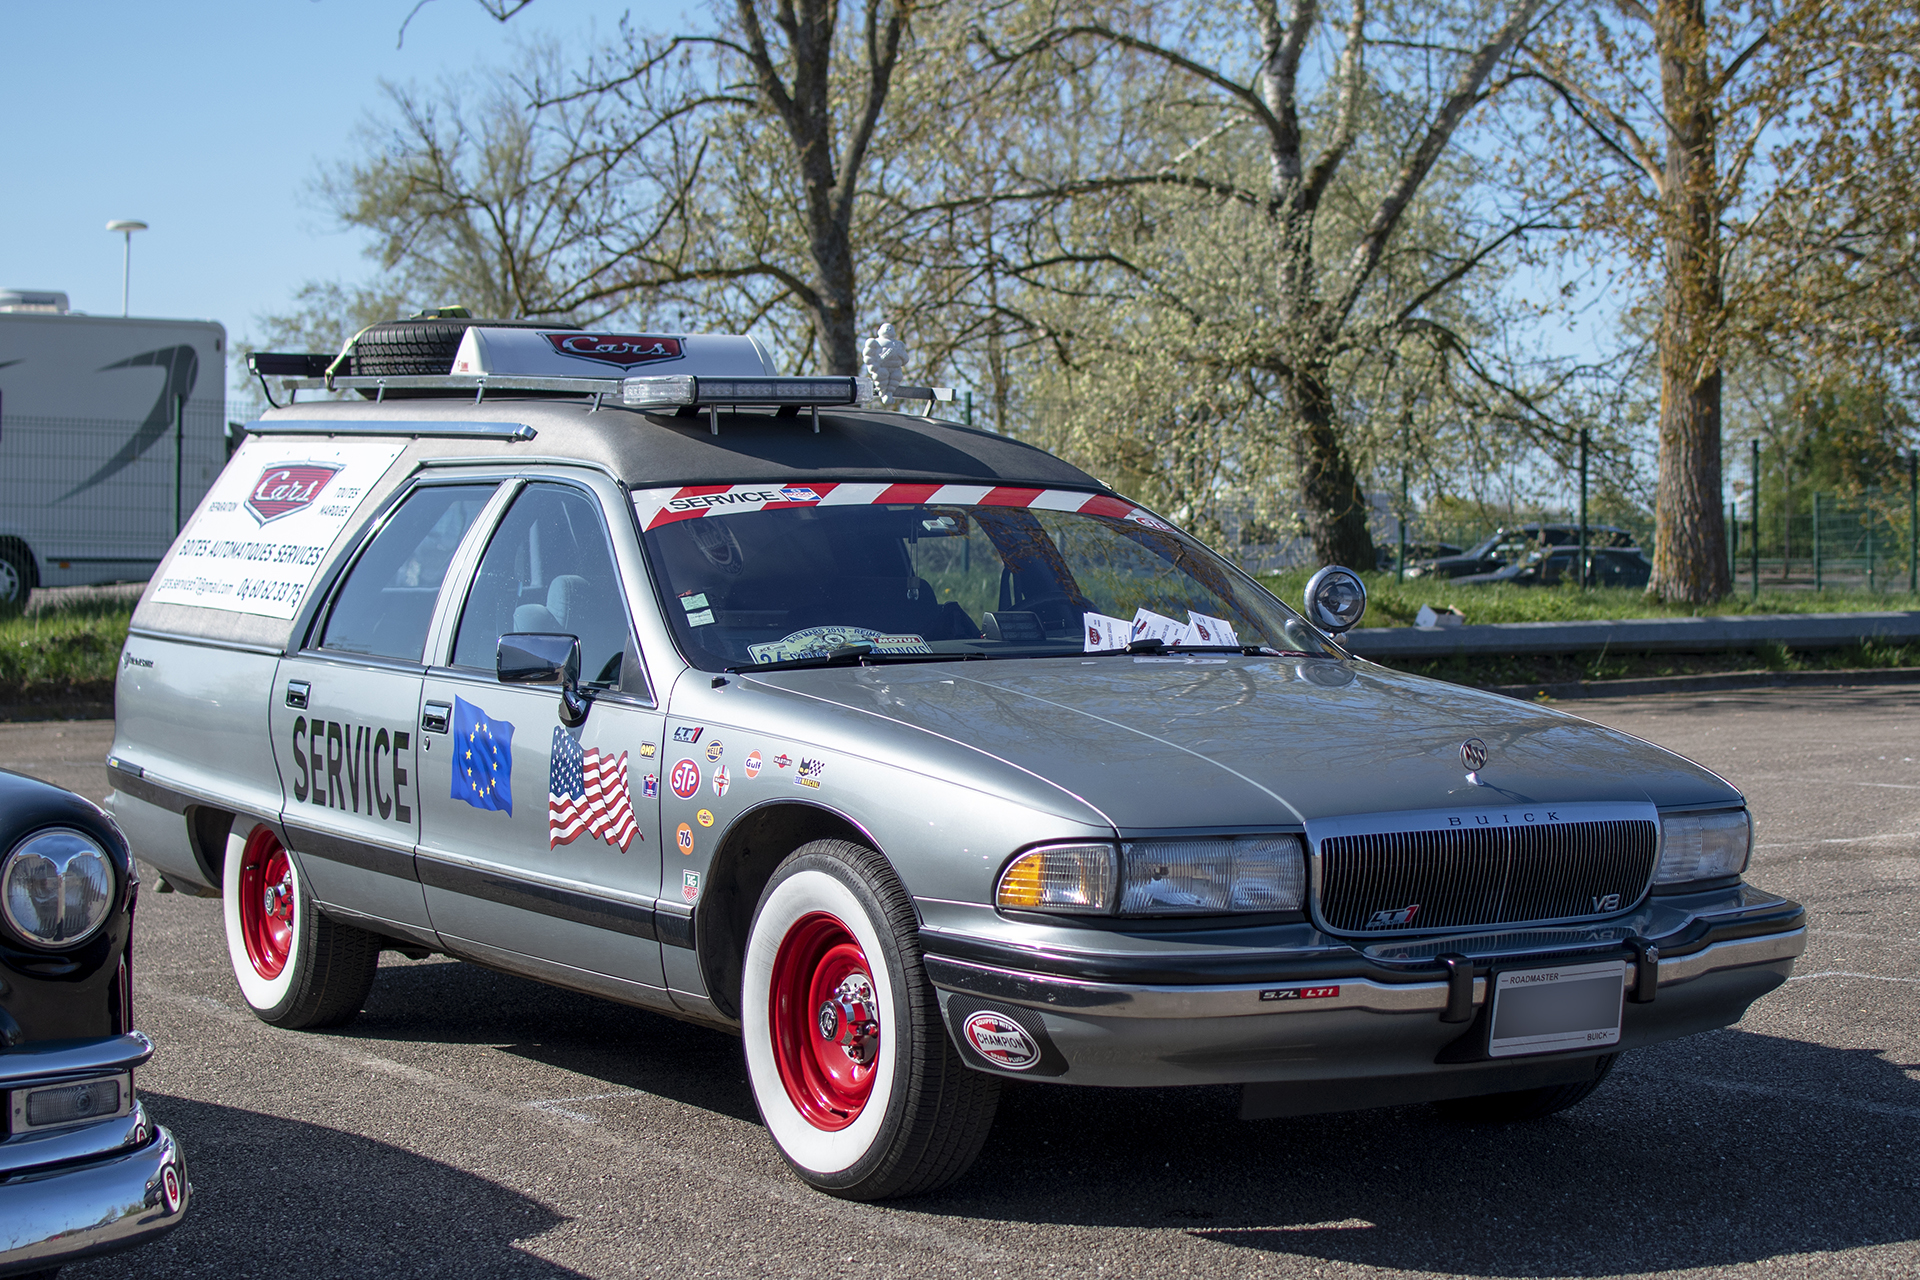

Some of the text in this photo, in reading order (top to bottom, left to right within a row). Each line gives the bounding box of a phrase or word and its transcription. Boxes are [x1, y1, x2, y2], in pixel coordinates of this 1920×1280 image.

[562, 336, 671, 355] Cars
[255, 471, 319, 502] Cars
[334, 487, 360, 498] TOUTES
[669, 490, 780, 510] SERVICE
[318, 505, 350, 517] MARQUES
[207, 540, 276, 562] AUTOMATIQUES
[273, 546, 324, 565] SERVICES
[854, 628, 882, 637] REIMS
[674, 726, 701, 741] LT1
[641, 744, 655, 756] OMP
[293, 715, 411, 824] SERVICE
[746, 758, 762, 770] Gulf
[673, 763, 697, 792] STP
[1448, 811, 1560, 827] BUICK
[679, 830, 691, 847] 76
[1592, 894, 1620, 912] V8
[1370, 905, 1419, 923] LT1
[1510, 972, 1559, 985] ROADMASTER
[1263, 988, 1334, 999] 5.7L LT1
[976, 1032, 1025, 1049] CHAMPION
[1587, 1031, 1608, 1041] BUICK
